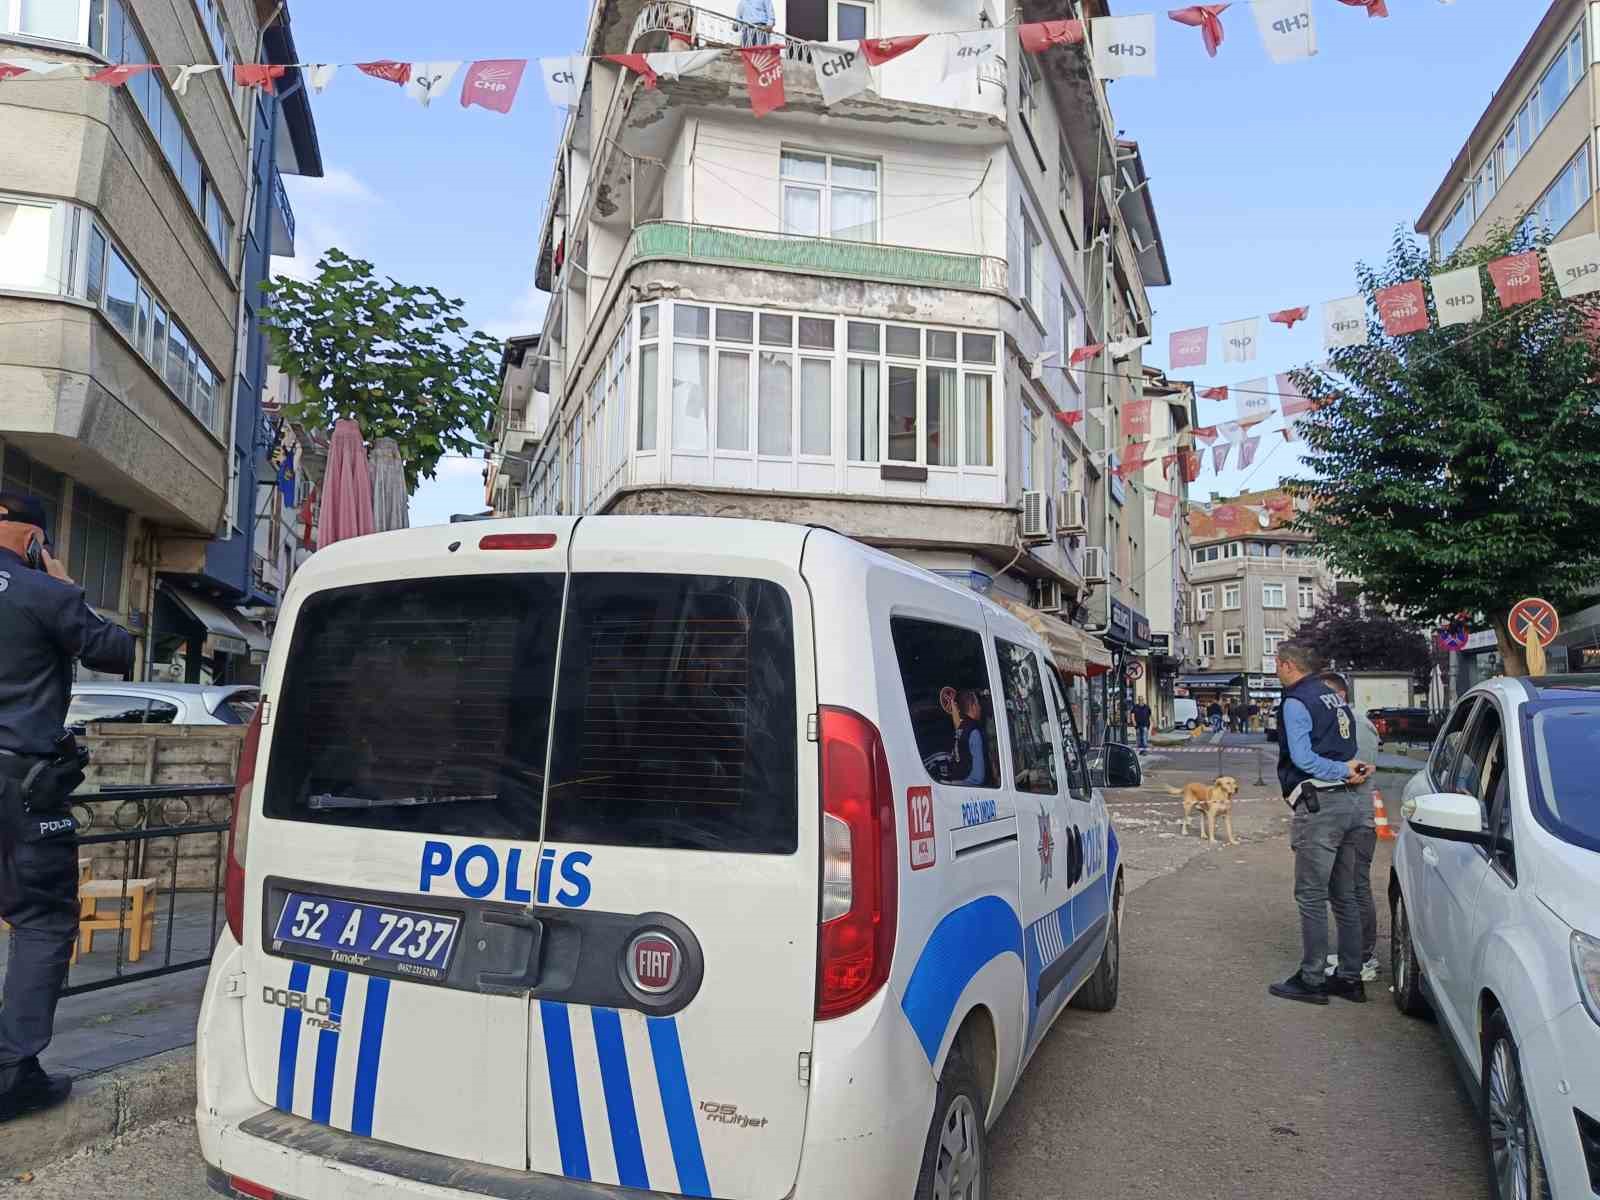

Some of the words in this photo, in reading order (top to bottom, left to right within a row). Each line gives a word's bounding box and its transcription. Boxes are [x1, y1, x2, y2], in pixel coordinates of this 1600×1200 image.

[551, 71, 575, 84] CH
[822, 51, 856, 78] CHP
[474, 79, 506, 93] CHP
[912, 795, 932, 834] 112
[291, 901, 329, 940] 52
[339, 908, 362, 946] A
[371, 913, 453, 961] 7237
[639, 950, 671, 979] FIAT
[263, 986, 330, 1016] DOBLO
[700, 1101, 737, 1115] 105
